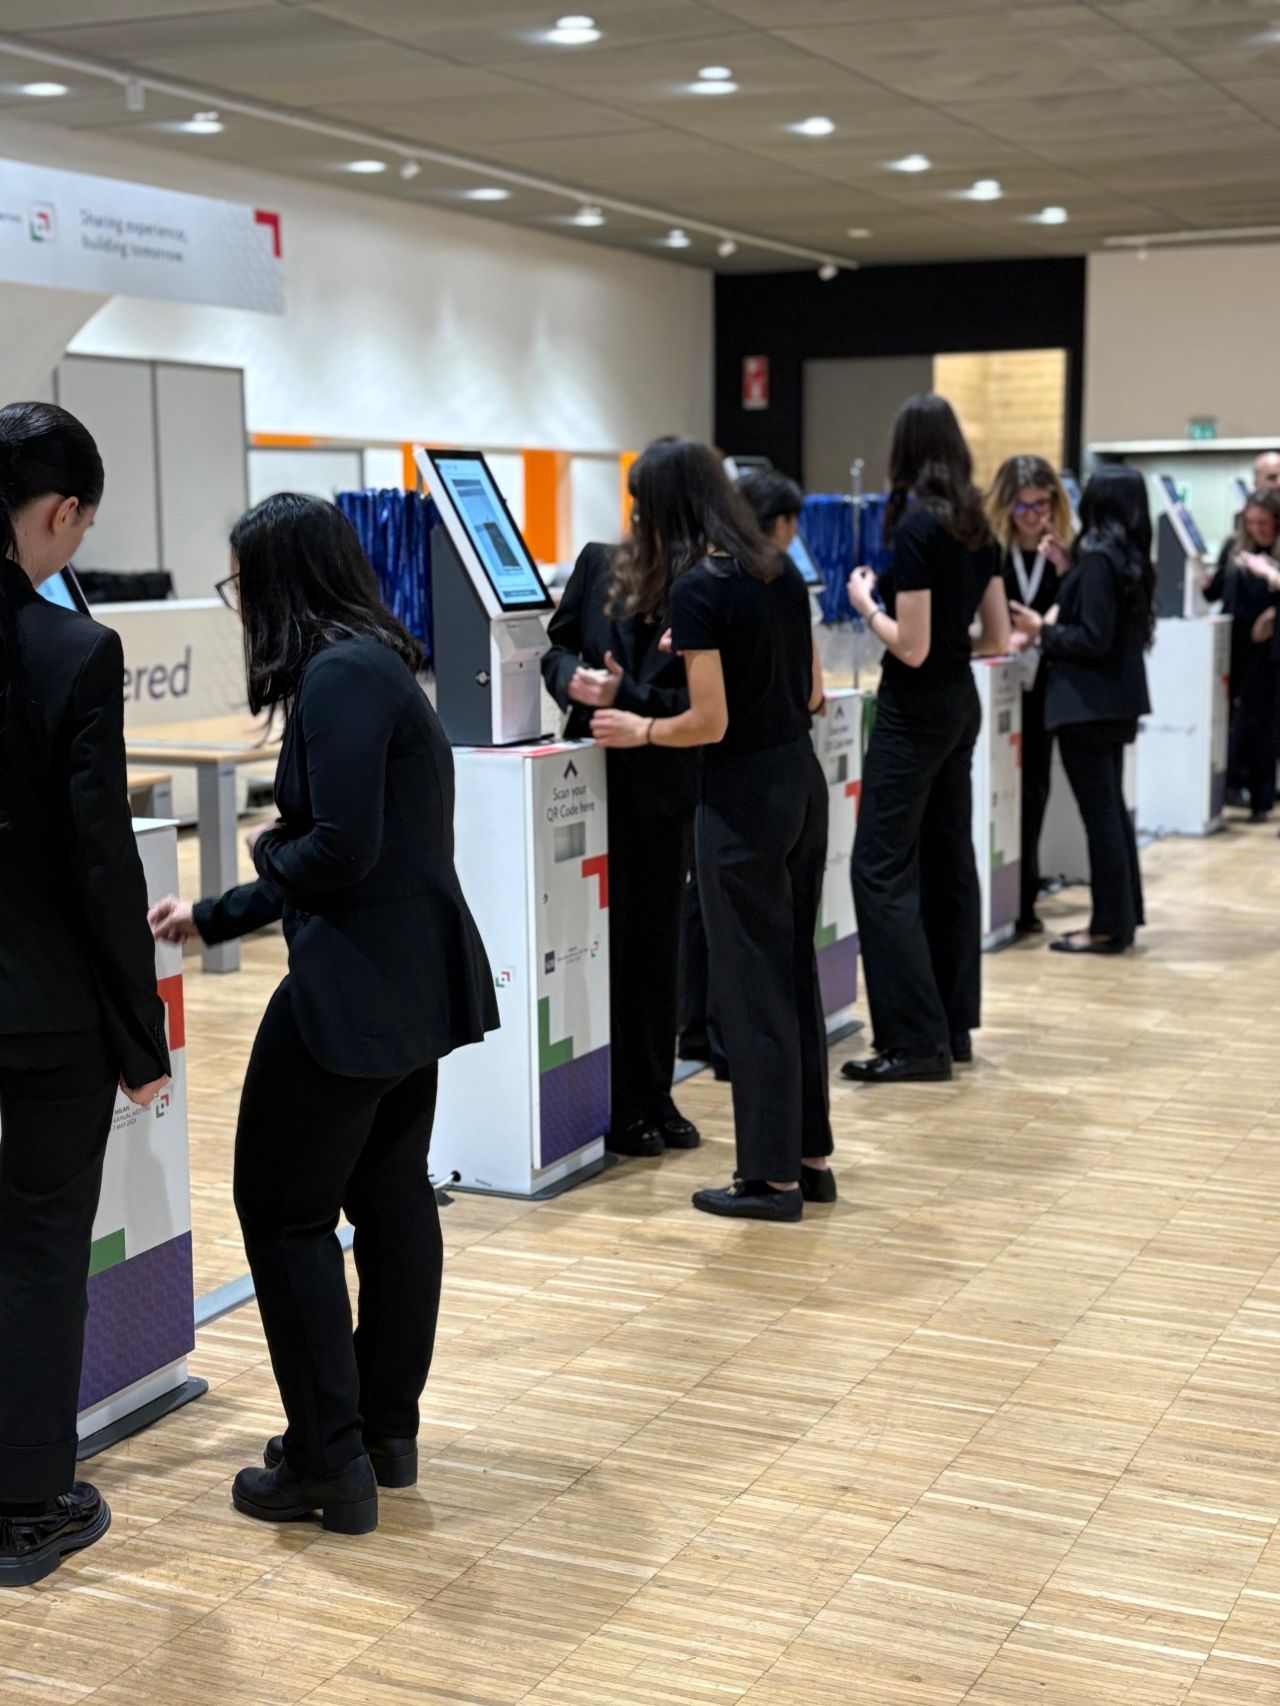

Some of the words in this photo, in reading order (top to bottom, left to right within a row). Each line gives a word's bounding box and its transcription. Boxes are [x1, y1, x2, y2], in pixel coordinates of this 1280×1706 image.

[80, 207, 122, 235] Sharing
[81, 233, 127, 259] building
[123, 646, 192, 702] ered
[553, 787, 570, 801] Scan
[571, 785, 587, 801] your
[546, 806, 559, 822] QR
[560, 803, 578, 818] Code
[580, 800, 595, 813] here
[115, 1106, 130, 1115] MILAN
